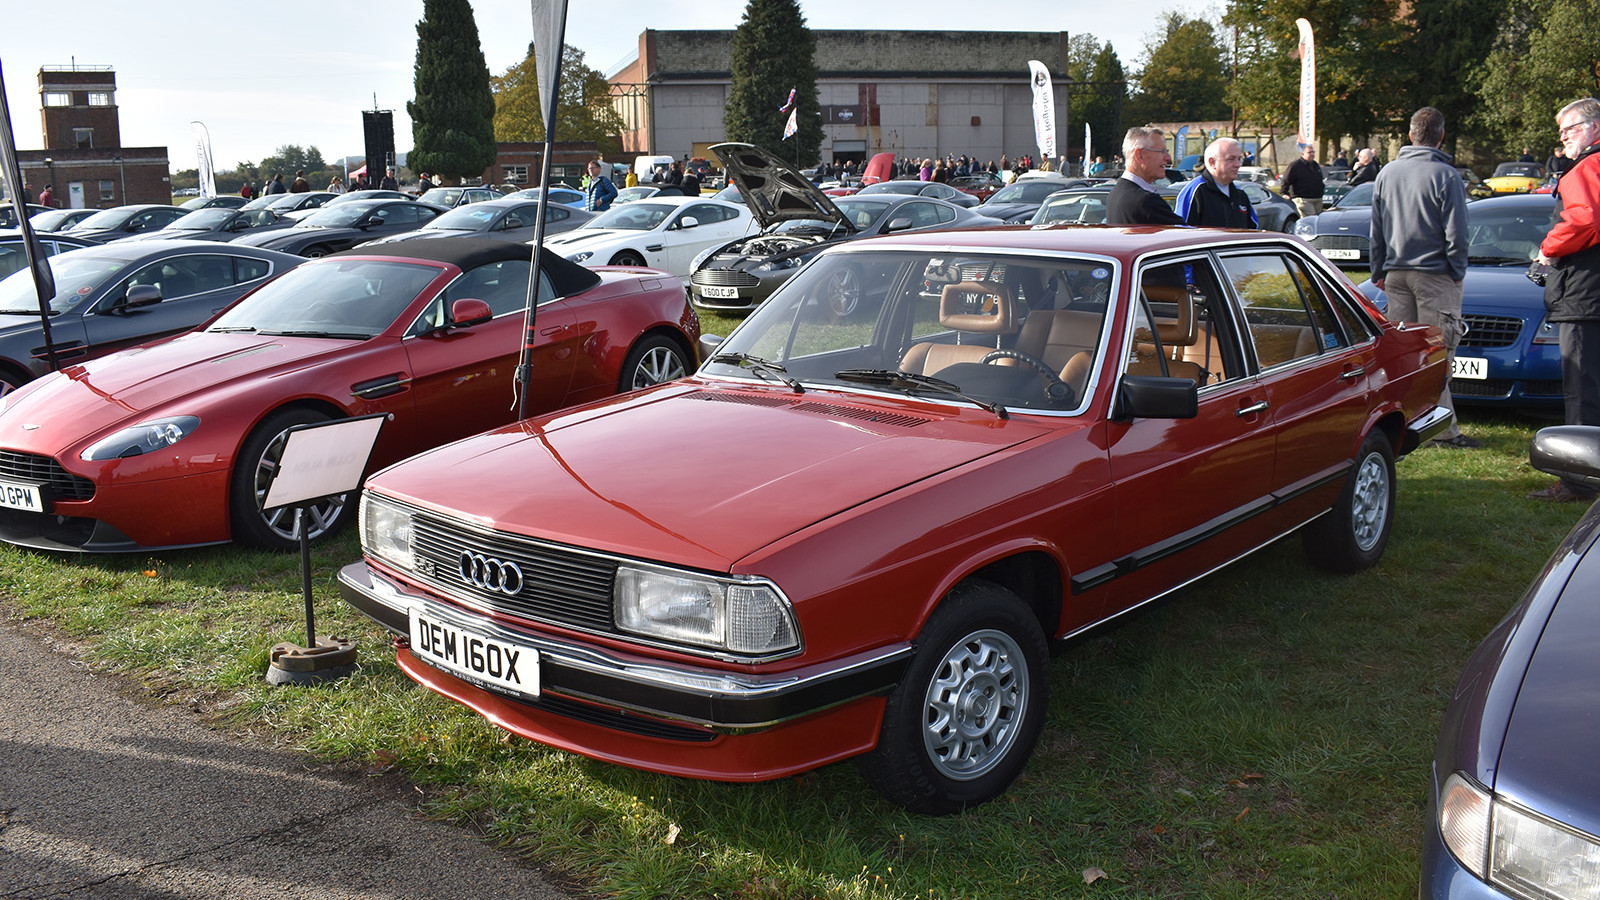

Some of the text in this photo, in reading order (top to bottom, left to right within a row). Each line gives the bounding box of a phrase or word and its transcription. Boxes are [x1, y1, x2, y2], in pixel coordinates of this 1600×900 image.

[703, 287, 735, 298] Y600 CJP
[966, 293, 979, 304] NY
[7, 486, 34, 508] GPM
[418, 617, 458, 665] DEM
[463, 635, 521, 685] 160X
